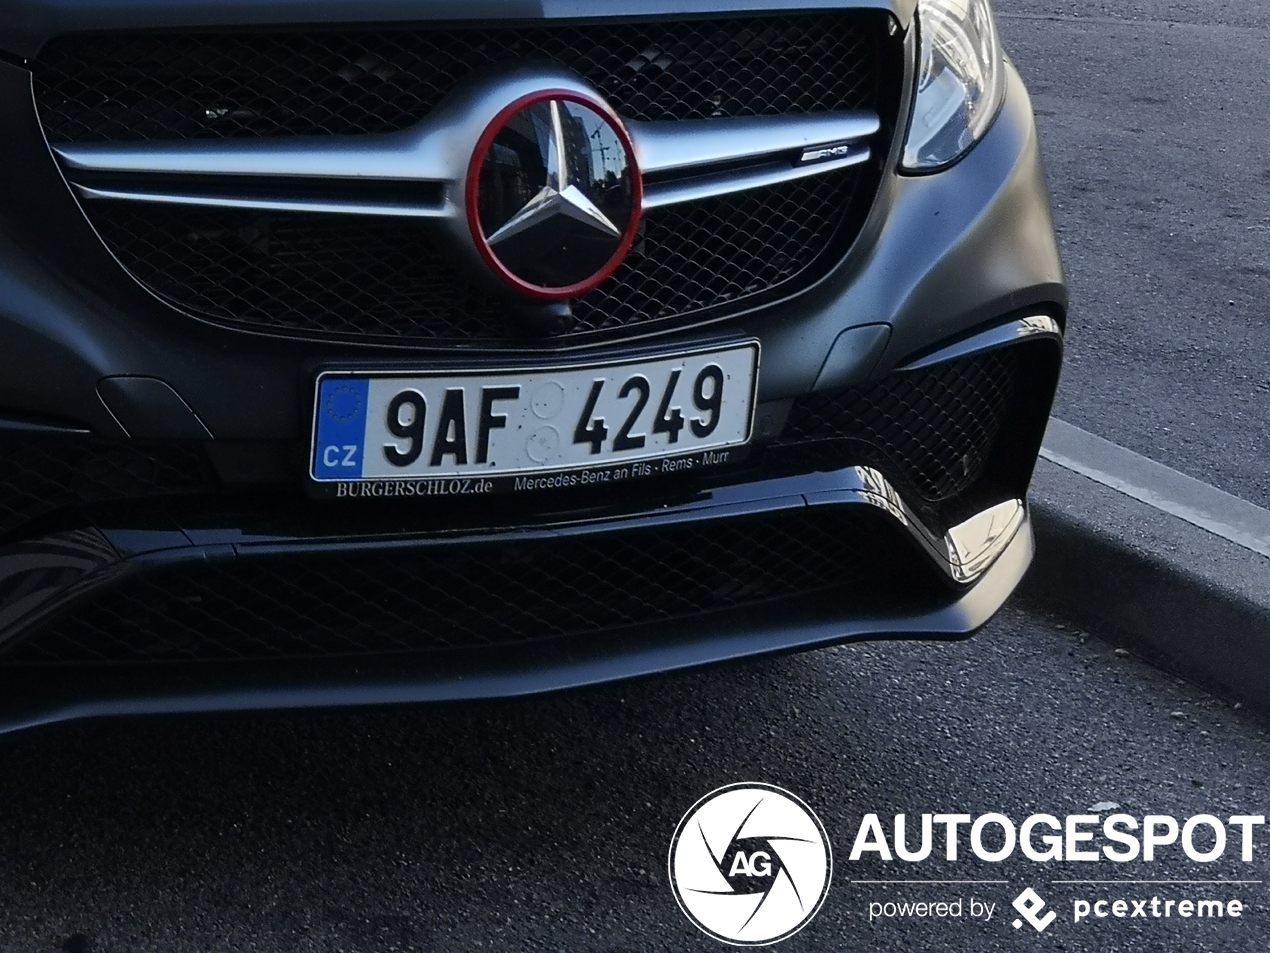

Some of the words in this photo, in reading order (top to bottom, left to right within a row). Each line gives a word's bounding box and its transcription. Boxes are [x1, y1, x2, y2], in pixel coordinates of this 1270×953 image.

[382, 384, 520, 467] 9AF
[573, 362, 725, 455] 4249
[323, 445, 357, 467] CZ
[514, 470, 610, 491] Mercedes-Benz
[613, 469, 628, 480] an
[631, 464, 651, 478] Fils
[661, 457, 693, 472] Rems
[702, 451, 729, 466] Murr
[336, 479, 493, 497] BURGERSCHLOZ.de
